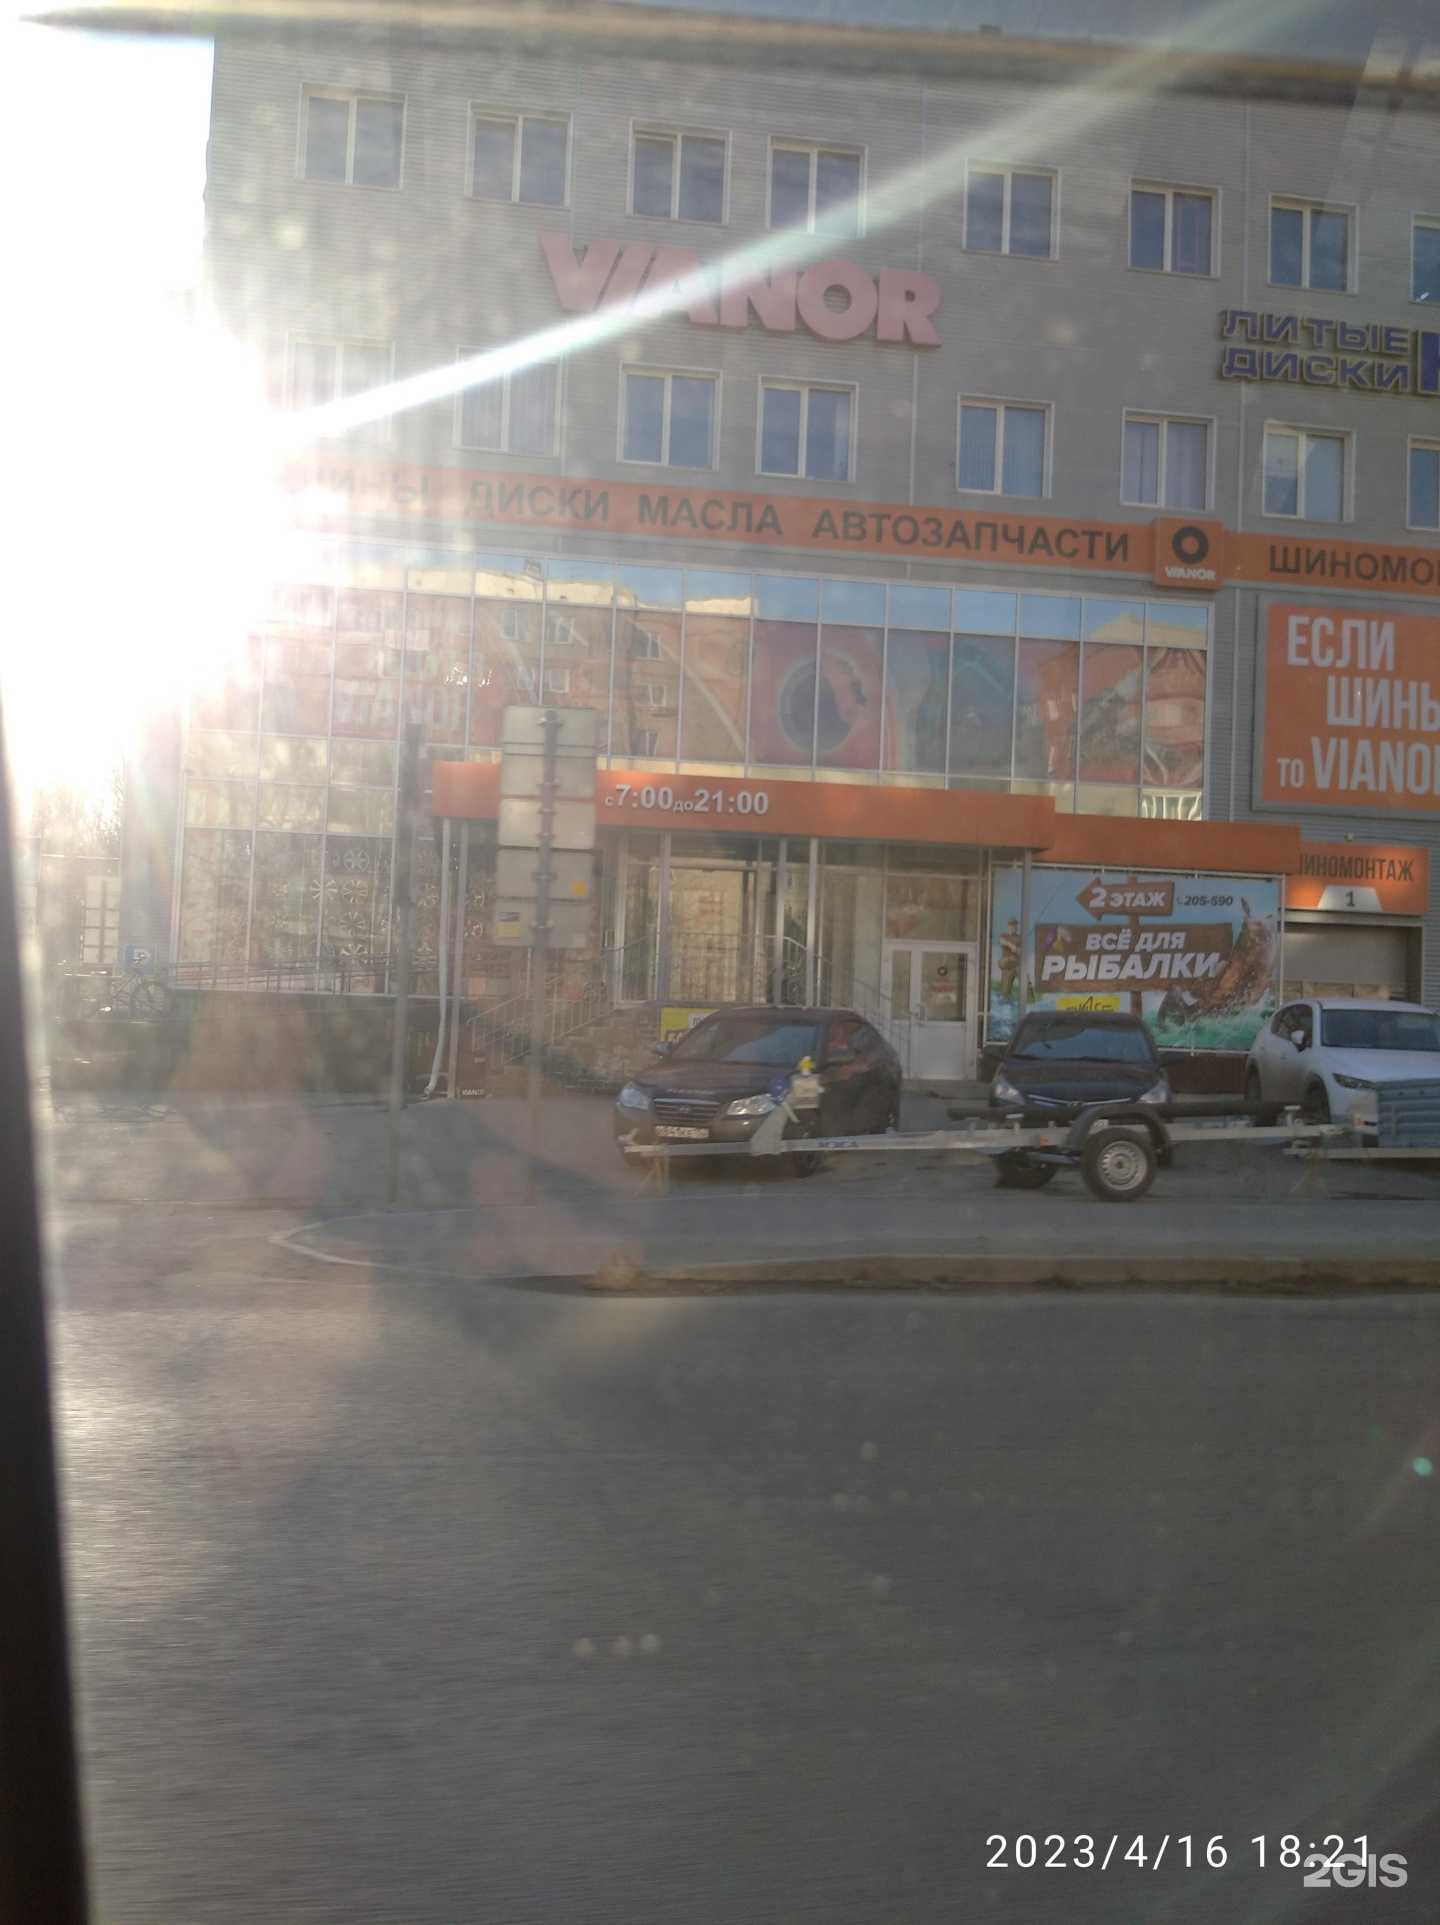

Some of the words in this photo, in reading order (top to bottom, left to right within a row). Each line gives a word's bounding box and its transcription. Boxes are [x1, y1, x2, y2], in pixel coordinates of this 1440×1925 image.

[1221, 308, 1411, 354] ЛИТЫЕ
[1220, 346, 1411, 393] ДИСКИ
[463, 478, 609, 522] ДИСКИ
[638, 494, 784, 535] МАСЛА
[812, 508, 1129, 561] АВТОЗАПЧАСТИ
[1269, 544, 1440, 586] ШИНОМО
[1287, 615, 1395, 672] ЕСЛИ
[1311, 735, 1440, 796] VIANO
[693, 788, 769, 815] 21:00
[1088, 887, 1106, 908] 2
[1109, 891, 1166, 908] ЭТАЖ
[1345, 890, 1355, 908] 1
[1086, 929, 1132, 951] ВСЁ
[1134, 932, 1187, 951] ДЛЯ
[1041, 952, 1221, 981] РЫБАЛКИ
